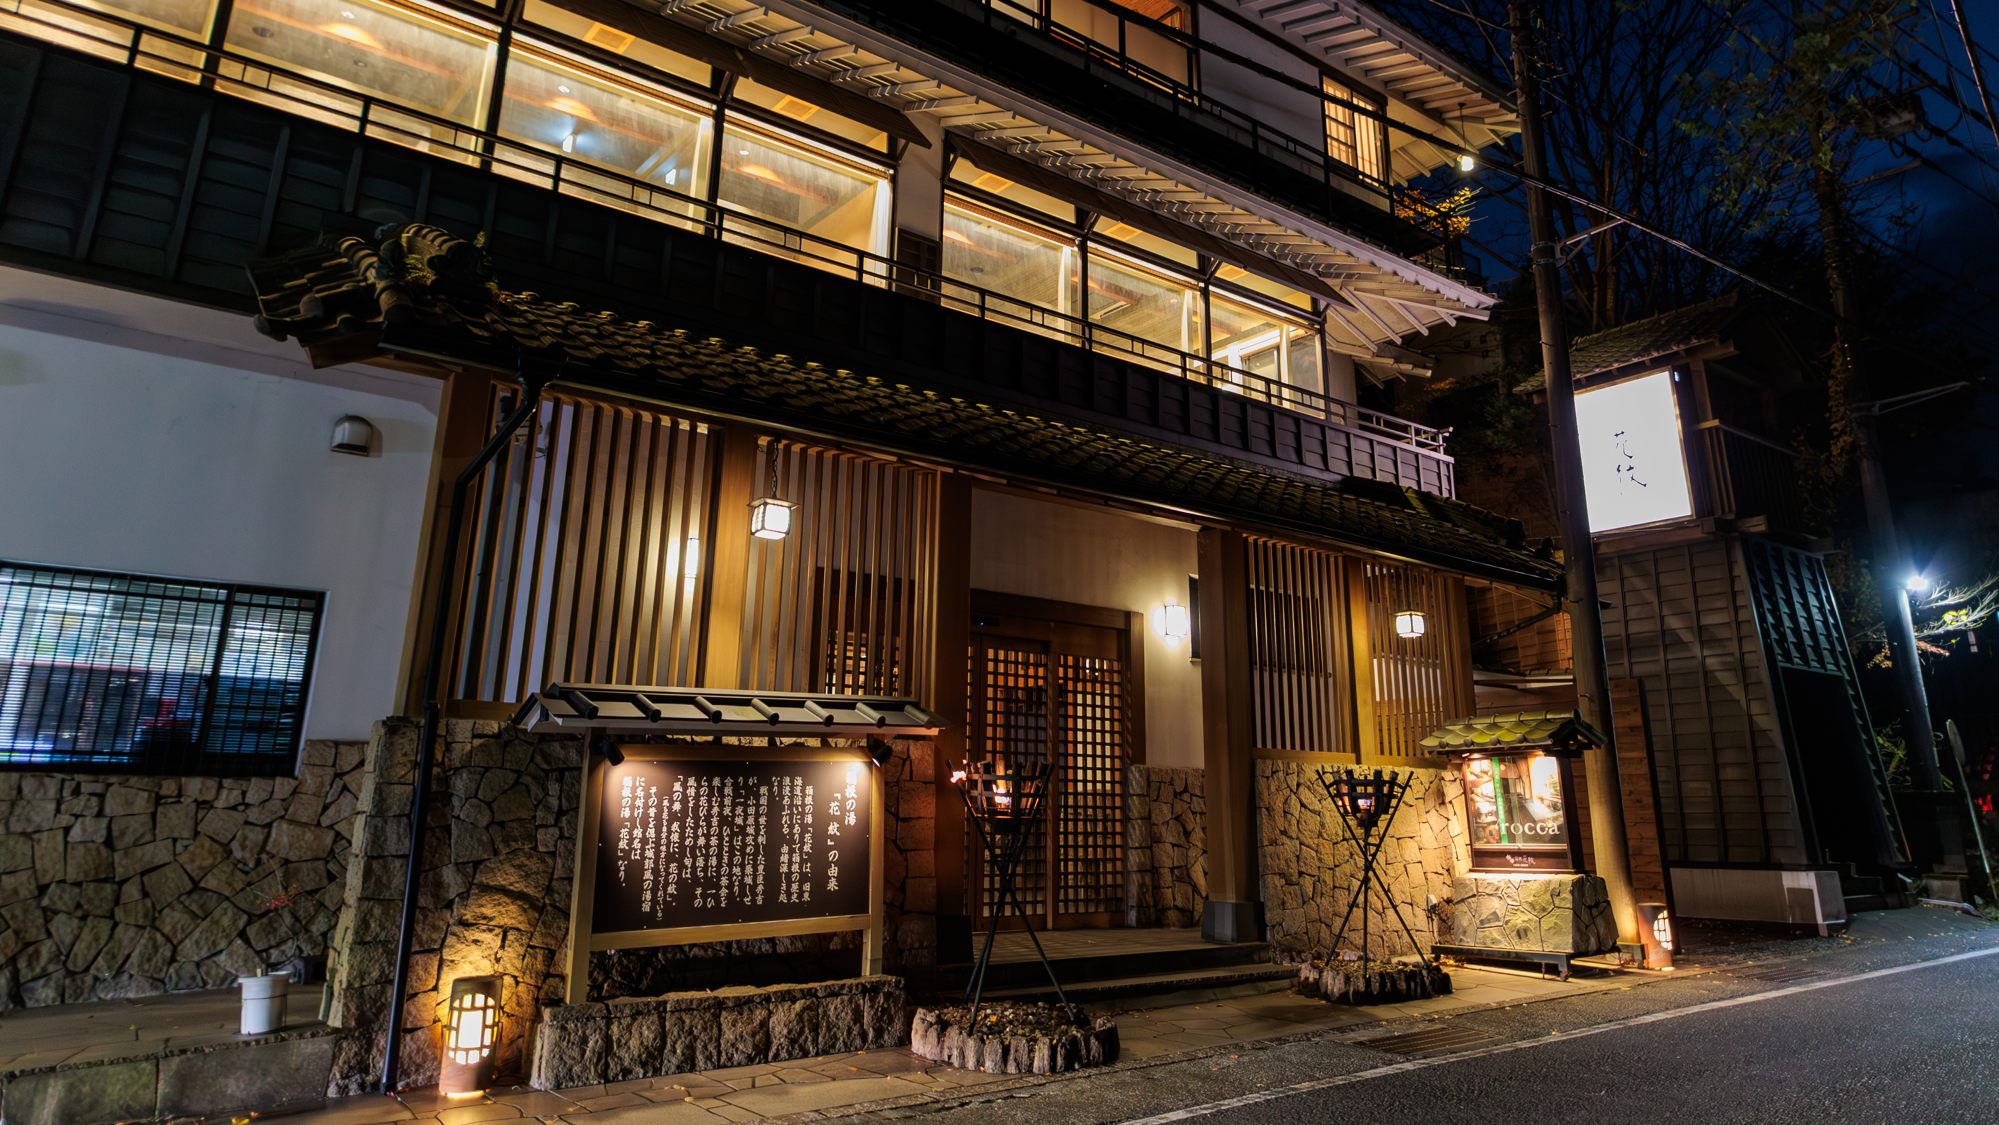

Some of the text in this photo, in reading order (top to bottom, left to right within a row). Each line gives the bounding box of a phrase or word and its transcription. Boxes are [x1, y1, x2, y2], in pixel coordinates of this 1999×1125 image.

[771, 776, 781, 801] なり。
[845, 771, 858, 825] 根の湯
[827, 793, 840, 891] 「花紋」の由来
[1500, 822, 1560, 835] rocca
